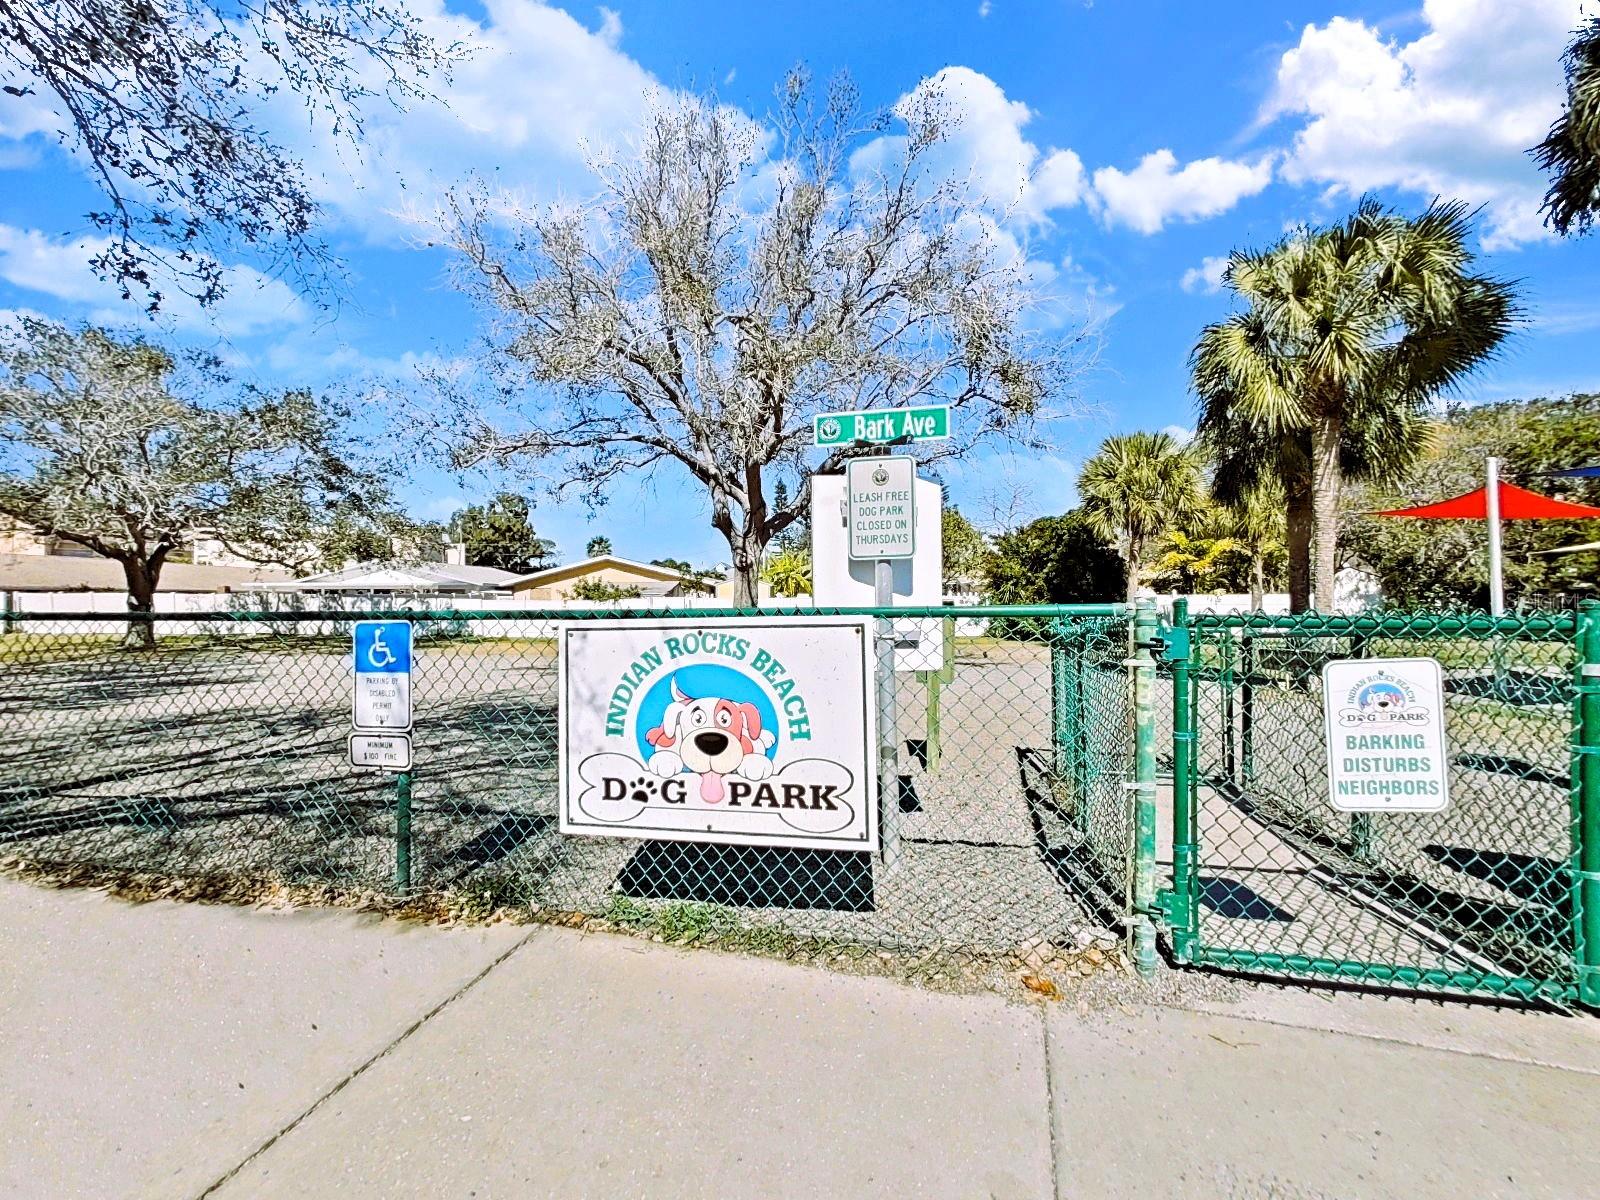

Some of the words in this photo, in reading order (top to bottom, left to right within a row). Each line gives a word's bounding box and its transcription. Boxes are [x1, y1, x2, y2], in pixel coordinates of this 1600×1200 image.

[854, 415, 895, 439] Bark
[902, 412, 935, 436] Ave
[853, 492, 883, 503] LEASH
[886, 490, 909, 501] FREE
[859, 507, 876, 516] DOG
[880, 505, 903, 515] PARK
[857, 520, 891, 531] CLOSED
[895, 519, 907, 529] ON
[856, 533, 909, 545] THURSDAYS
[366, 677, 389, 685] PARKING
[391, 677, 399, 685] BY
[605, 645, 665, 737] INDIAN
[664, 631, 751, 661] ROCKS
[750, 647, 812, 742] BEACH
[369, 689, 396, 697] DISABLED
[1347, 678, 1366, 704] INDIAN
[1367, 674, 1395, 683] ROCKS
[372, 702, 392, 710] PERMIT
[1389, 713, 1425, 721] PARK
[367, 741, 393, 749] MINIMUM
[1345, 734, 1425, 750] BARKING
[384, 753, 398, 761] FINE
[1343, 757, 1431, 773] DISTURBS
[1338, 780, 1439, 796] NEIGHBORS
[728, 782, 838, 810] PARK
